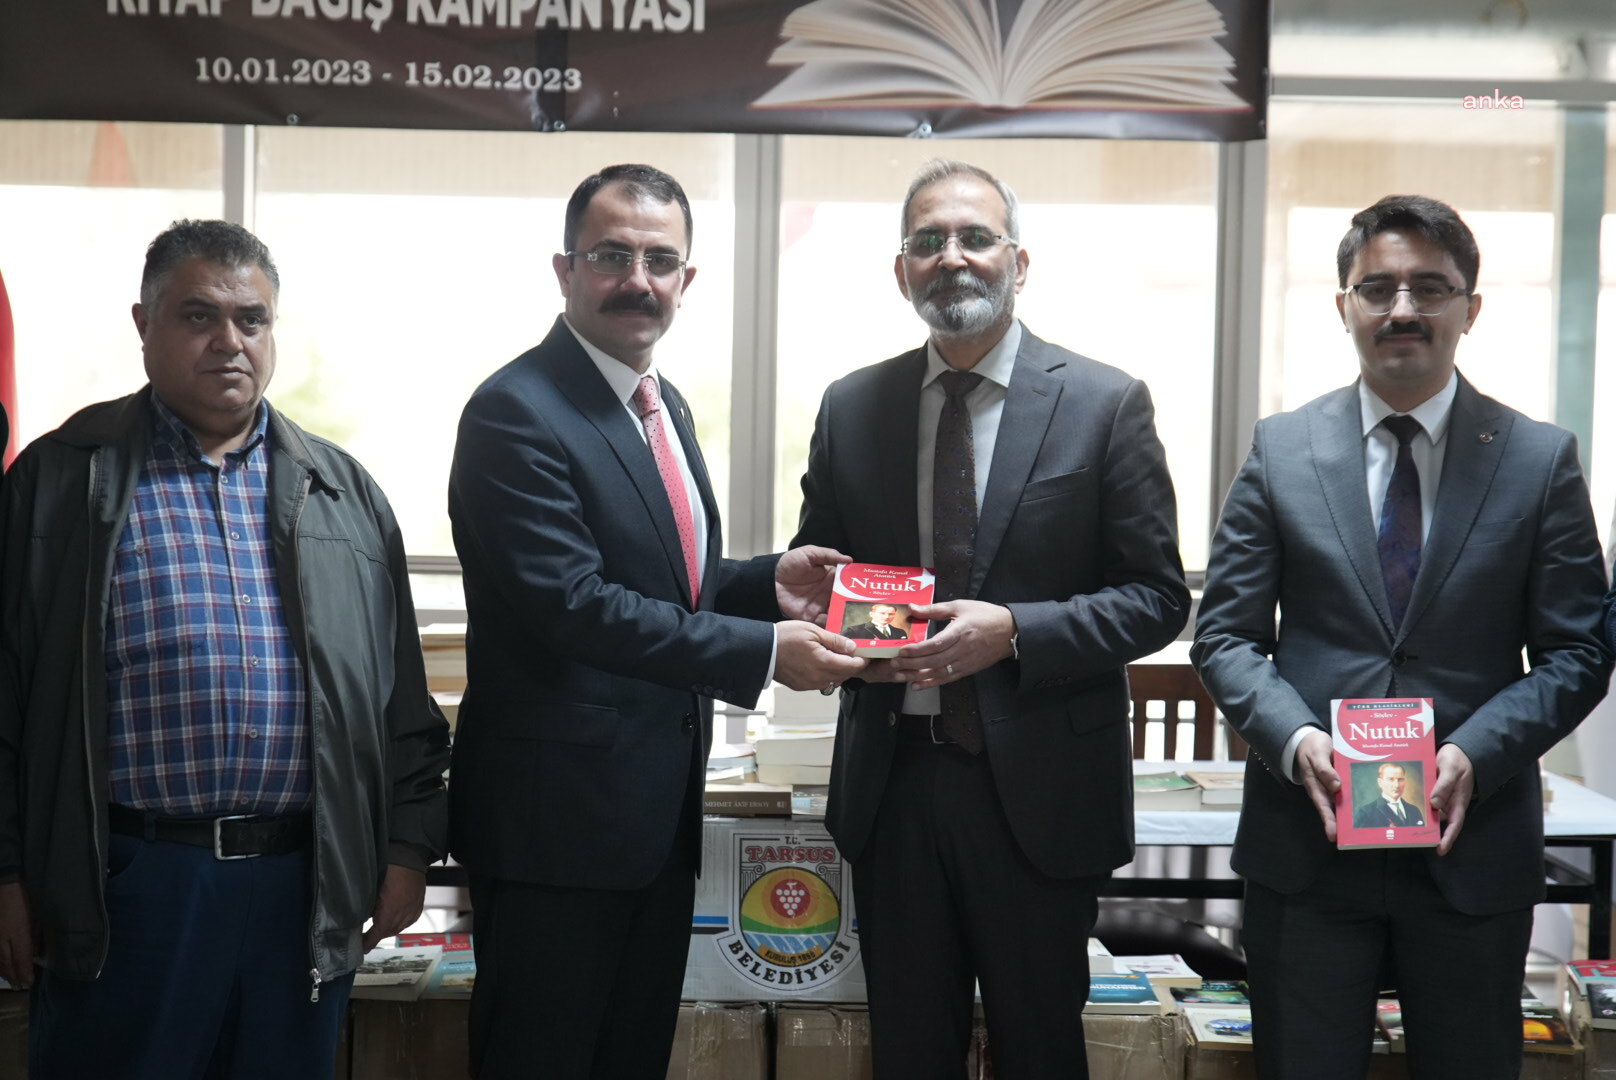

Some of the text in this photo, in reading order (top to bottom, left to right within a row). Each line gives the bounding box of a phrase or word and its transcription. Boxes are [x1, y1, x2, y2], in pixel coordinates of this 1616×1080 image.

[195, 57, 371, 85] 10.01.2023
[404, 61, 583, 92] 15.02.2023
[850, 577, 916, 591] Nutuk
[1348, 720, 1420, 741] Nutuk
[745, 845, 837, 863] TARSUS
[728, 939, 851, 985] BELEDİYESİ
